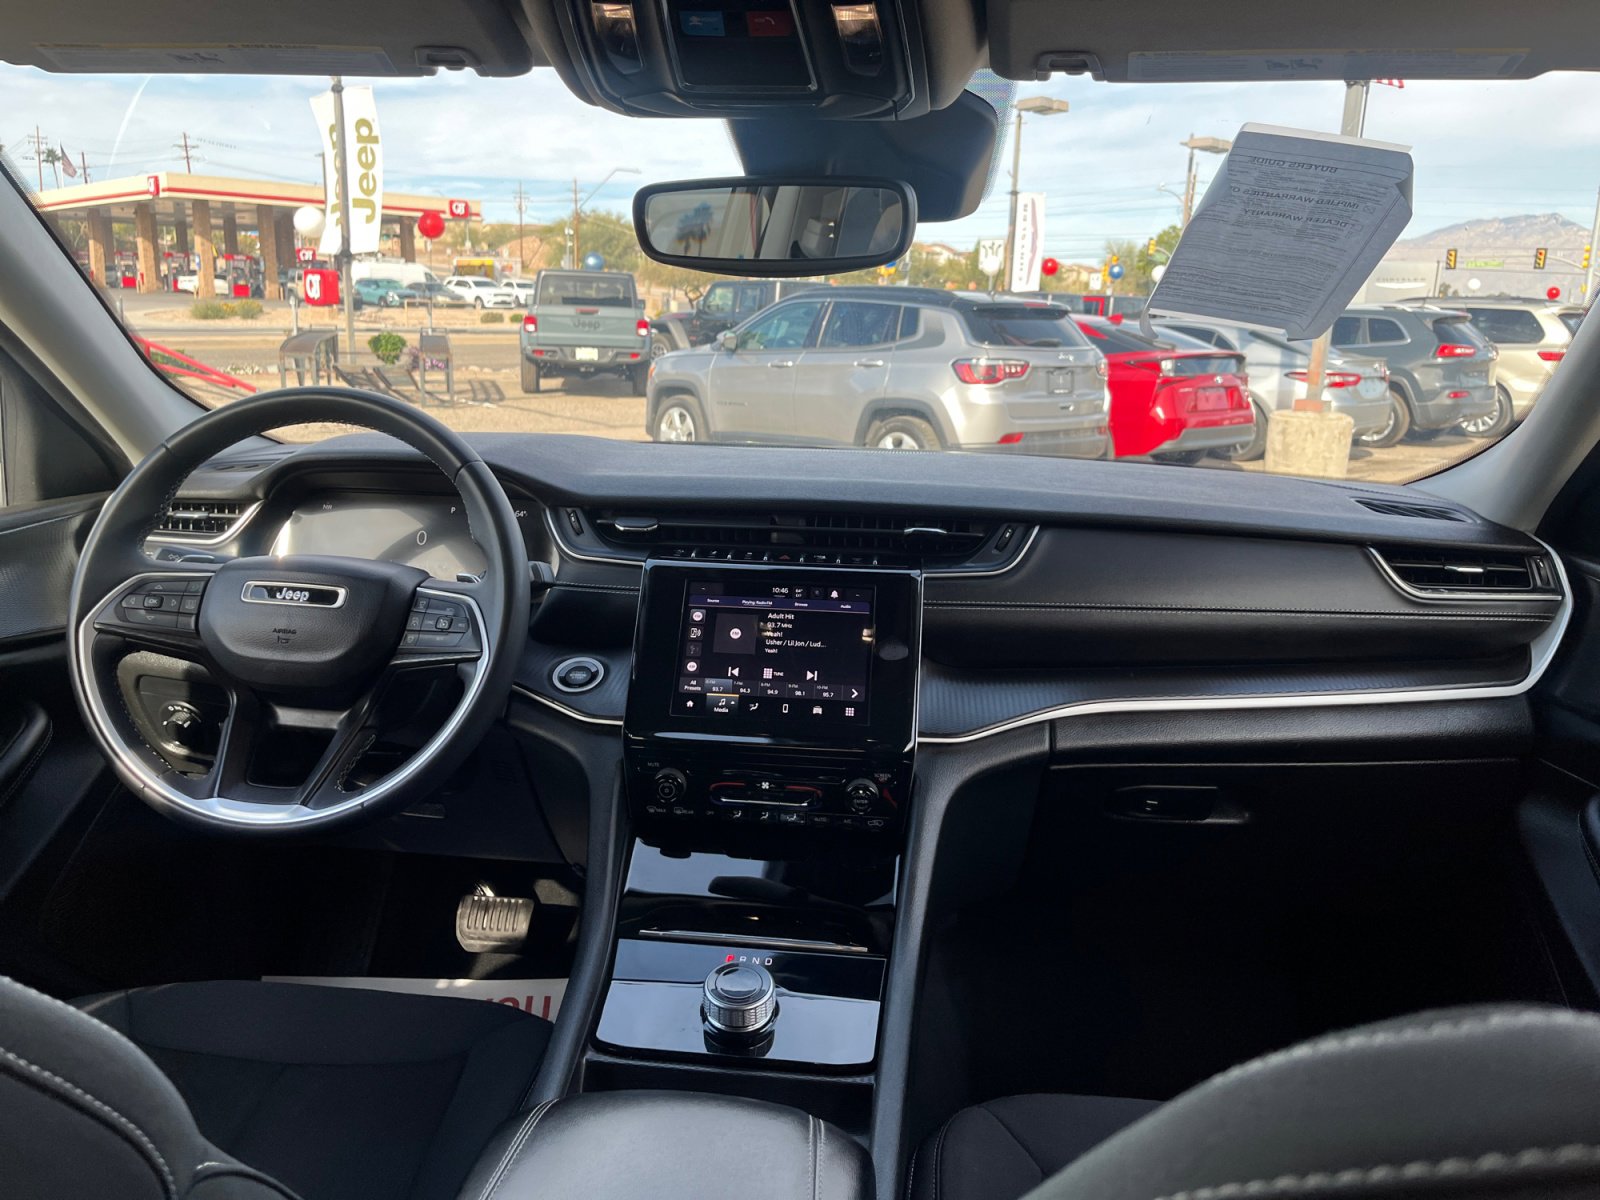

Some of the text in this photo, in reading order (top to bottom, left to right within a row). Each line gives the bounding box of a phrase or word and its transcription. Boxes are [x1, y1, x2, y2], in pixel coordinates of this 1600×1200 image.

[352, 117, 380, 225] Jeep
[305, 273, 321, 300] QT
[416, 530, 428, 545] 0
[276, 588, 310, 602] Jeep
[772, 587, 789, 595] 10:46
[752, 957, 760, 965] N
[765, 958, 773, 966] D
